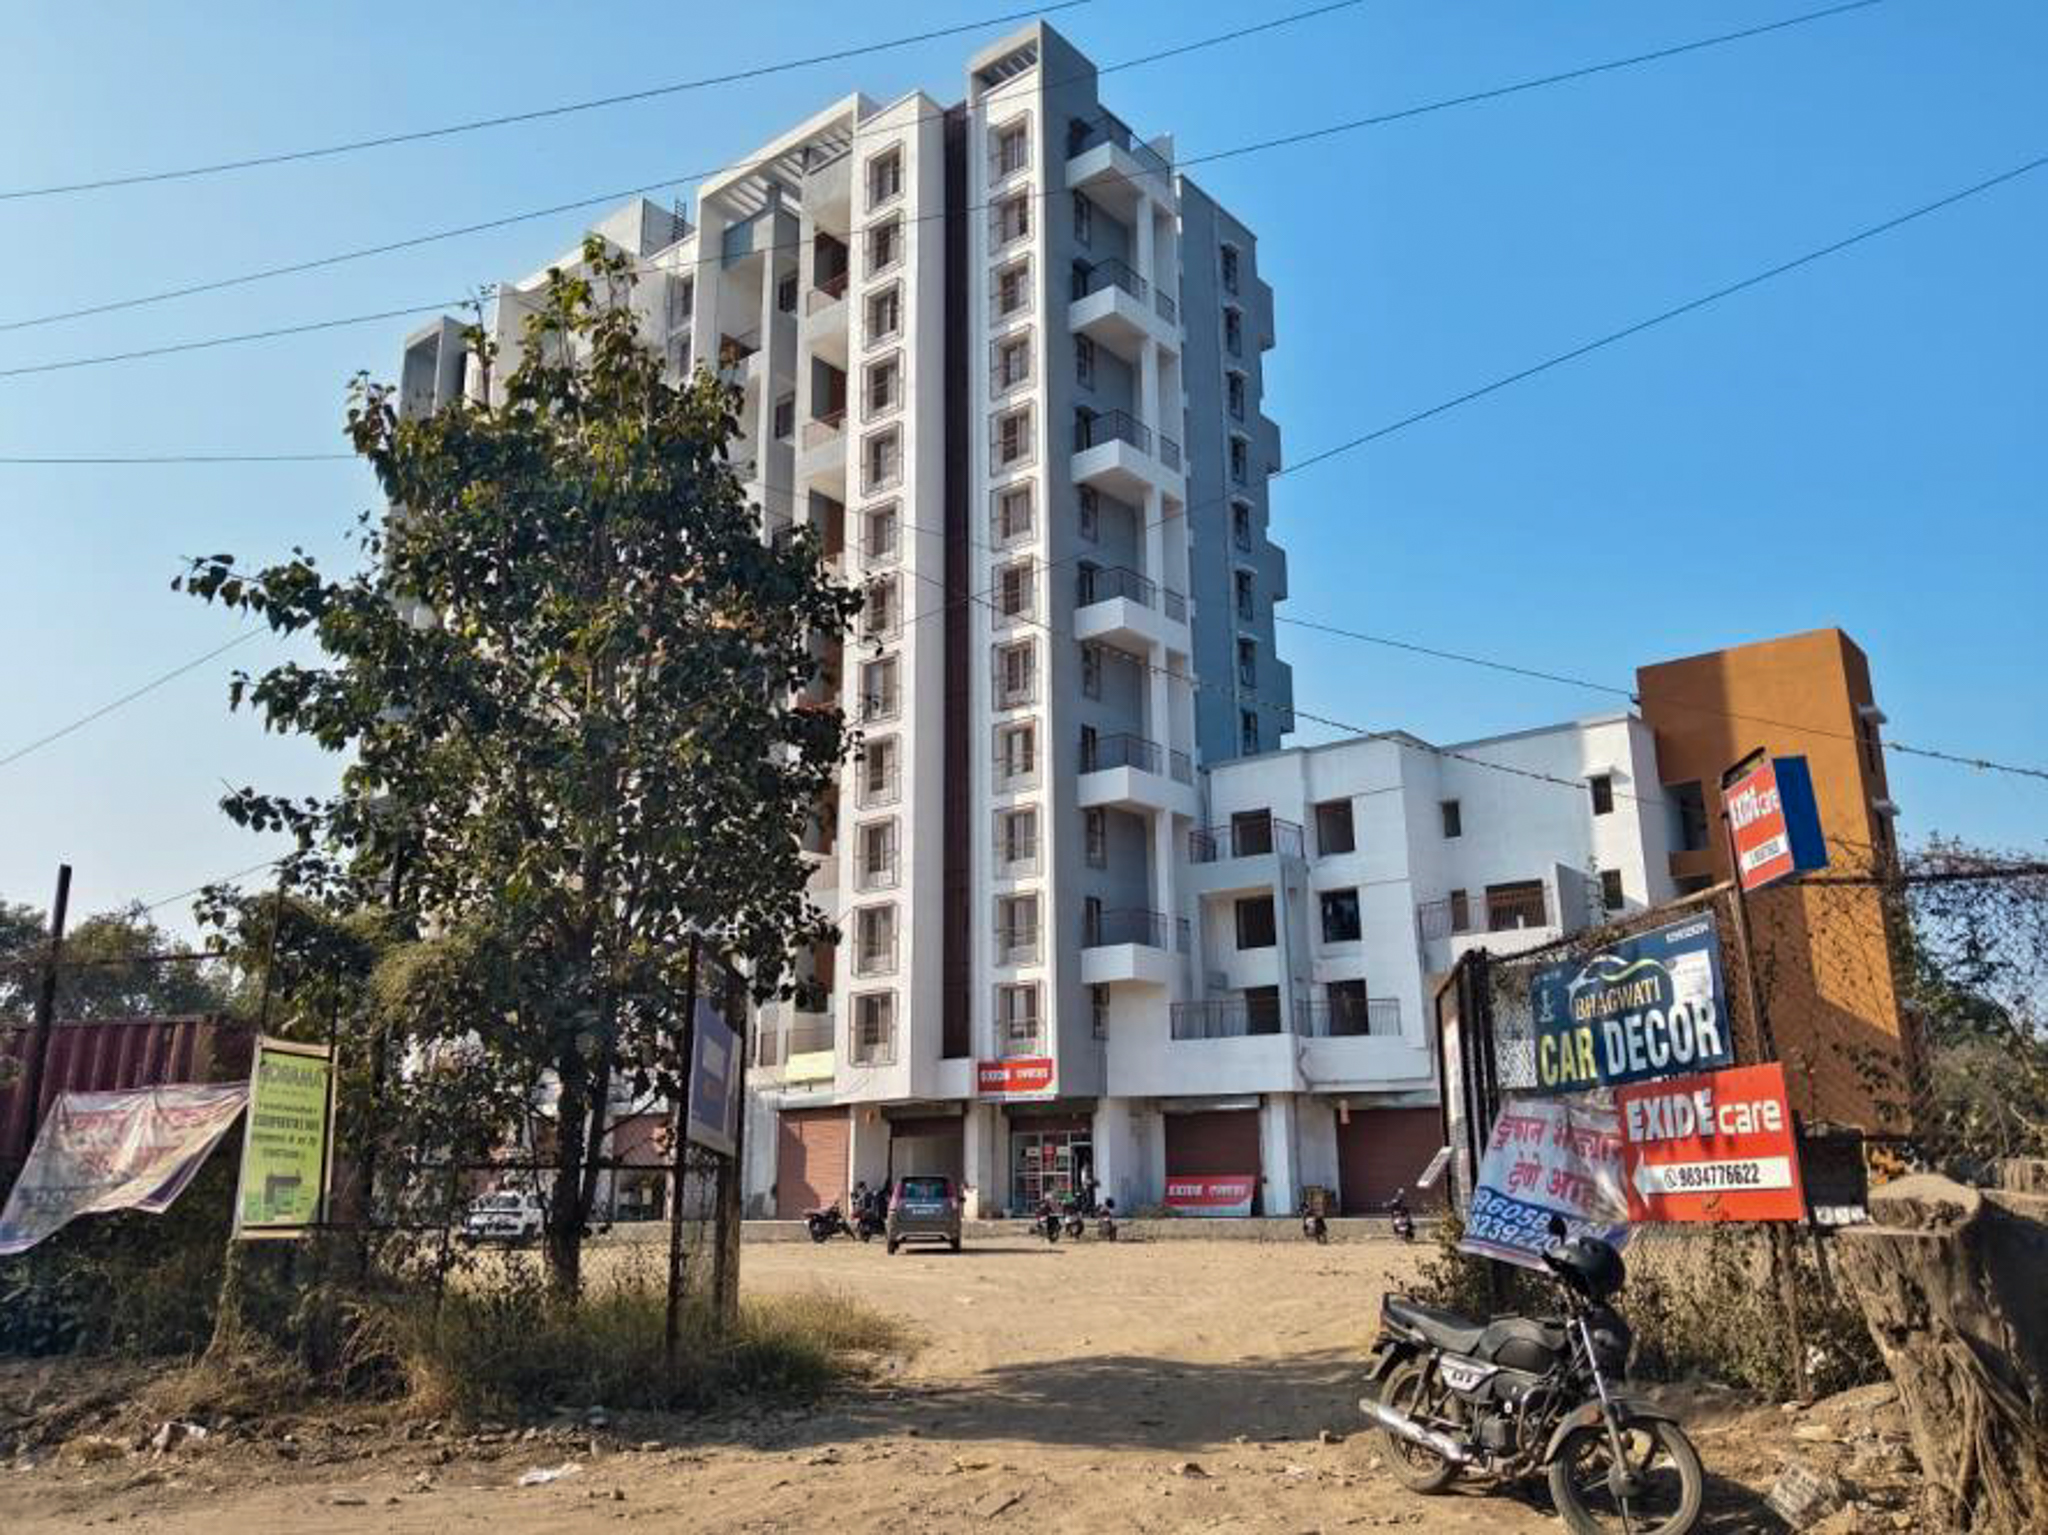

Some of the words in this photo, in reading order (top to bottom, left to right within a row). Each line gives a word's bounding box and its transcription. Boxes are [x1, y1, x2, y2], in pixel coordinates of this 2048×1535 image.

[1575, 975, 1662, 1021] BHAGWATI
[1540, 1027, 1598, 1087] CAR
[1603, 998, 1723, 1076] DECOR
[1626, 1087, 1715, 1142] EXIDE
[1718, 1099, 1783, 1134] care
